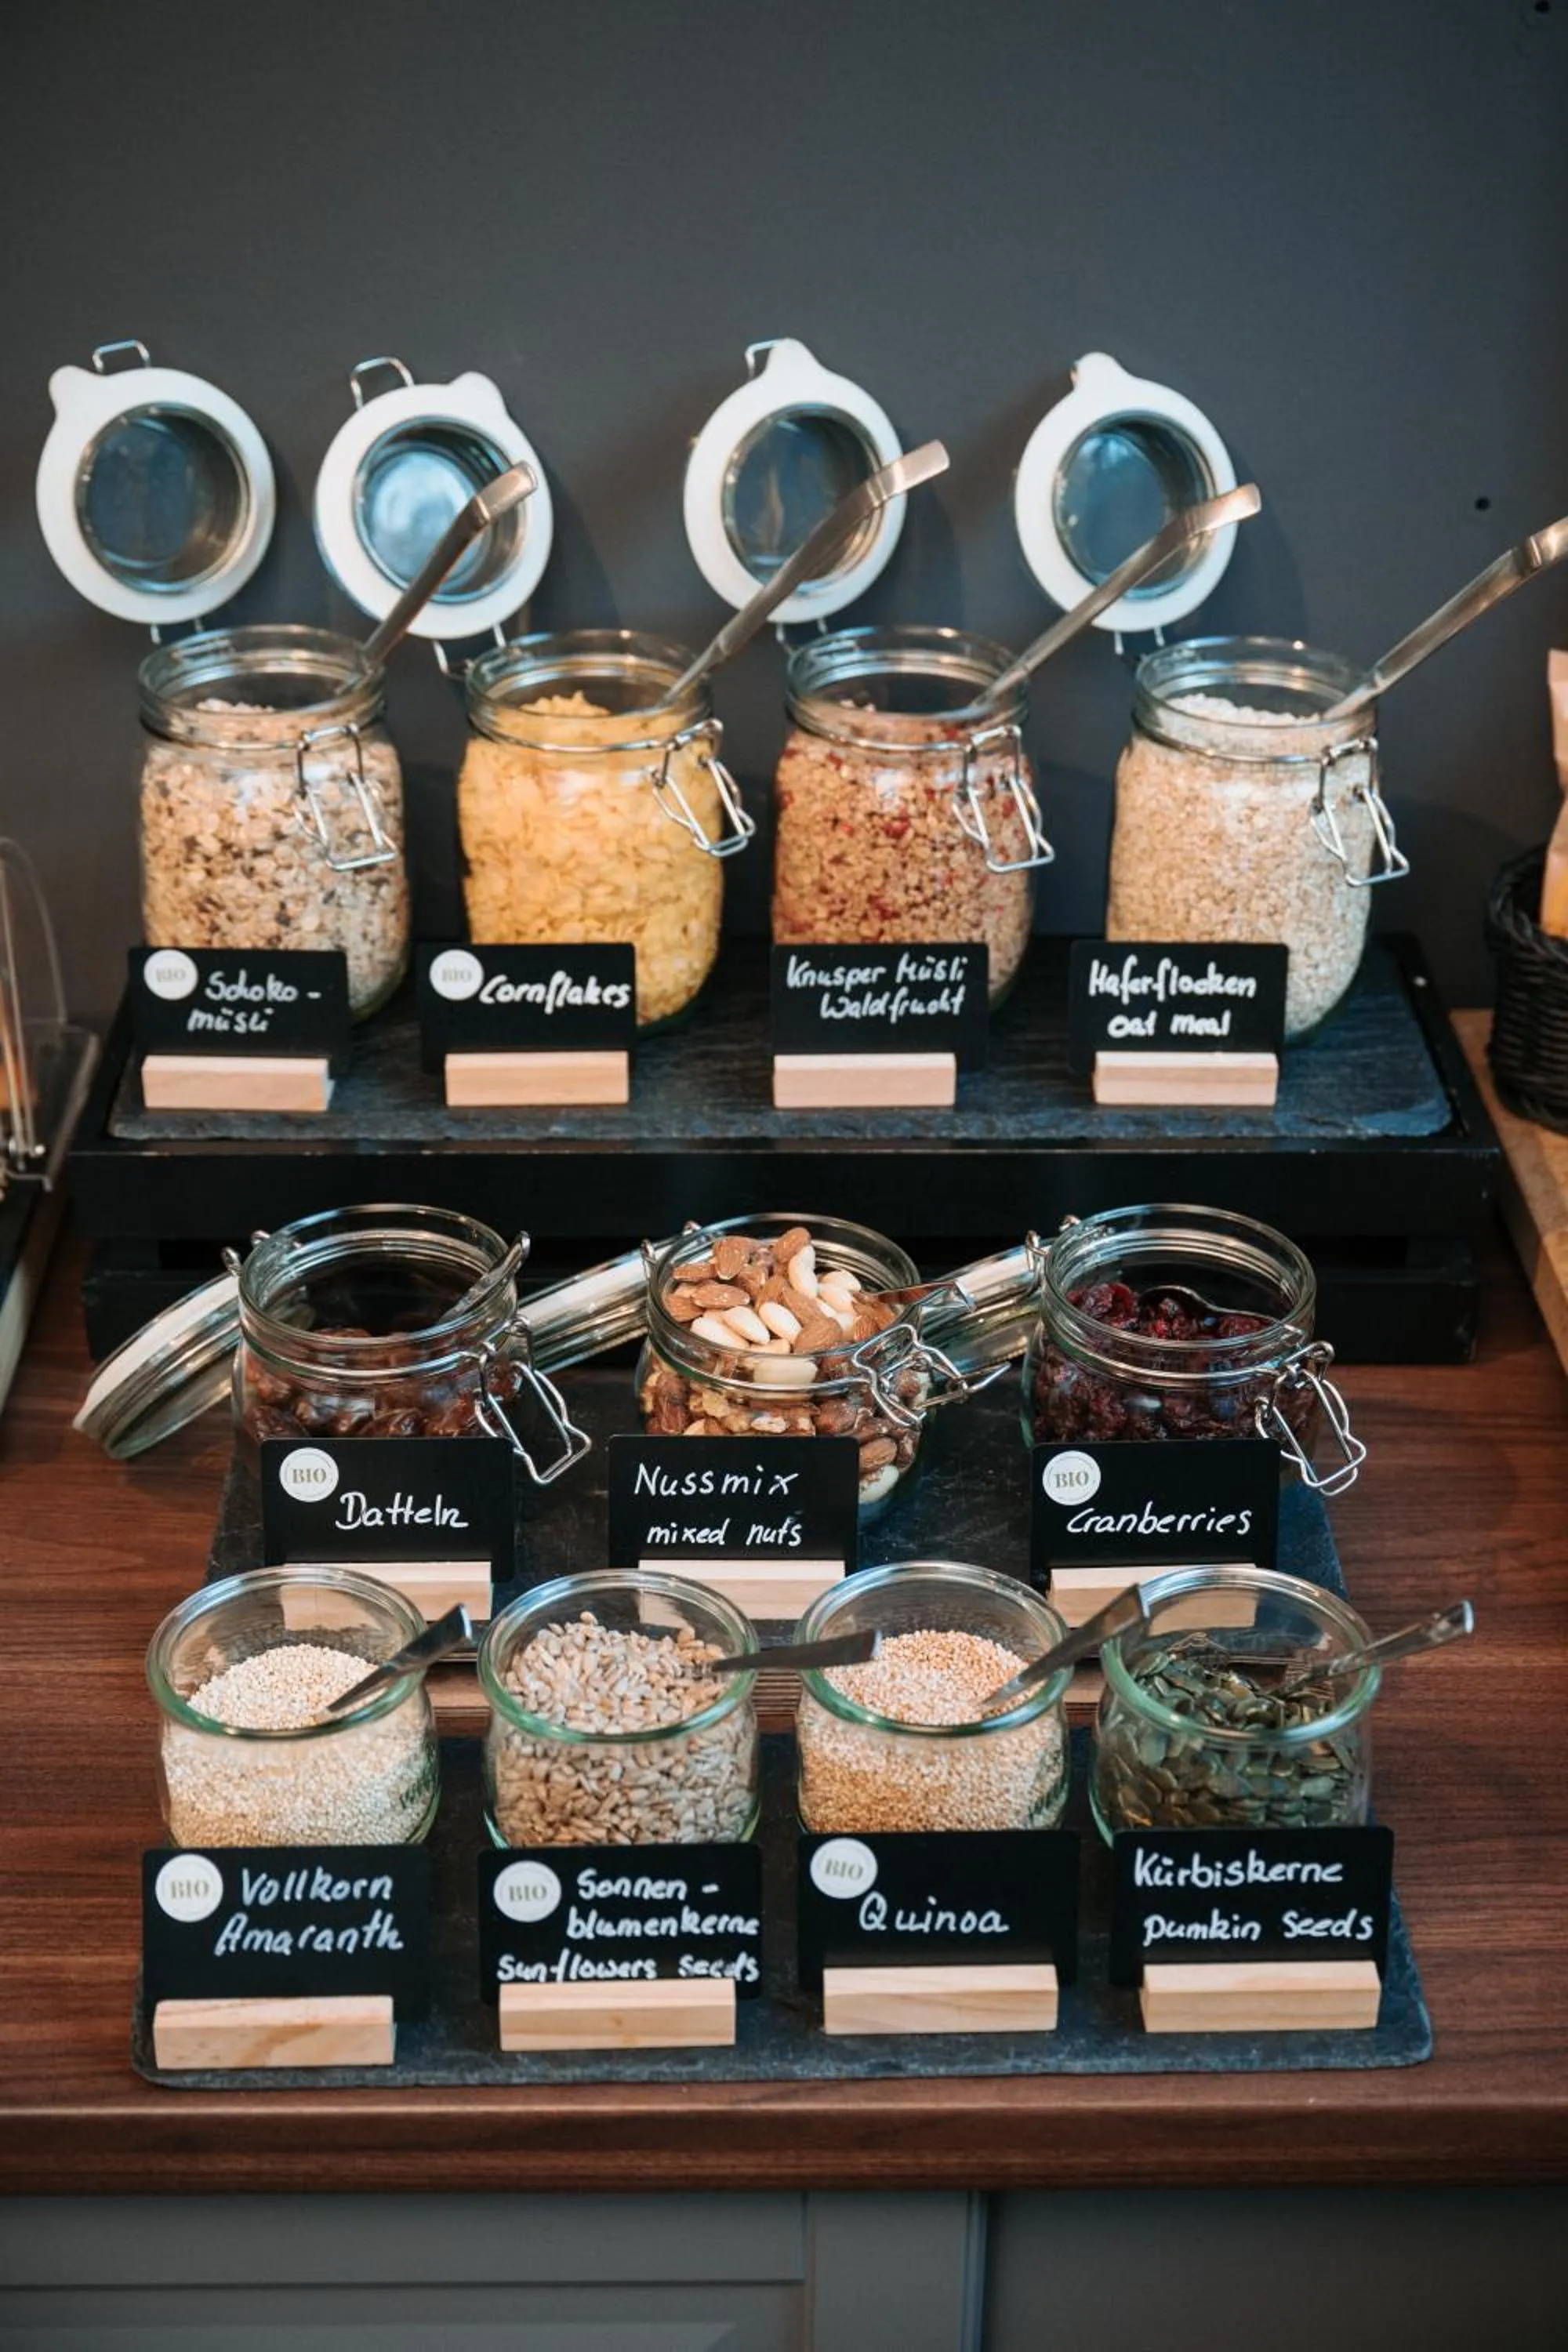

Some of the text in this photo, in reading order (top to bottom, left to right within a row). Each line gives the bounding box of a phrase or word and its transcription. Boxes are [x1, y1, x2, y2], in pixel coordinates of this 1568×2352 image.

[441, 967, 472, 982] BIO
[479, 969, 632, 1015] Cornflakes
[786, 954, 887, 993] Knusper
[1087, 953, 1258, 1006] Haferflocken
[291, 1468, 327, 1484] BIO
[1054, 1471, 1090, 1488] BIO
[334, 1490, 470, 1531] Datteln
[1065, 1500, 1253, 1536] Cranberries
[646, 1515, 803, 1548] mixed nuts
[241, 1866, 394, 1907] Vollkorn
[824, 1860, 864, 1880] BIO
[1134, 1847, 1344, 1889] Kürbiskerne
[169, 1880, 209, 1900] BIO
[508, 1883, 547, 1903] BIO
[858, 1891, 1010, 1934] Quinoa
[213, 1911, 405, 1957] Amaranth
